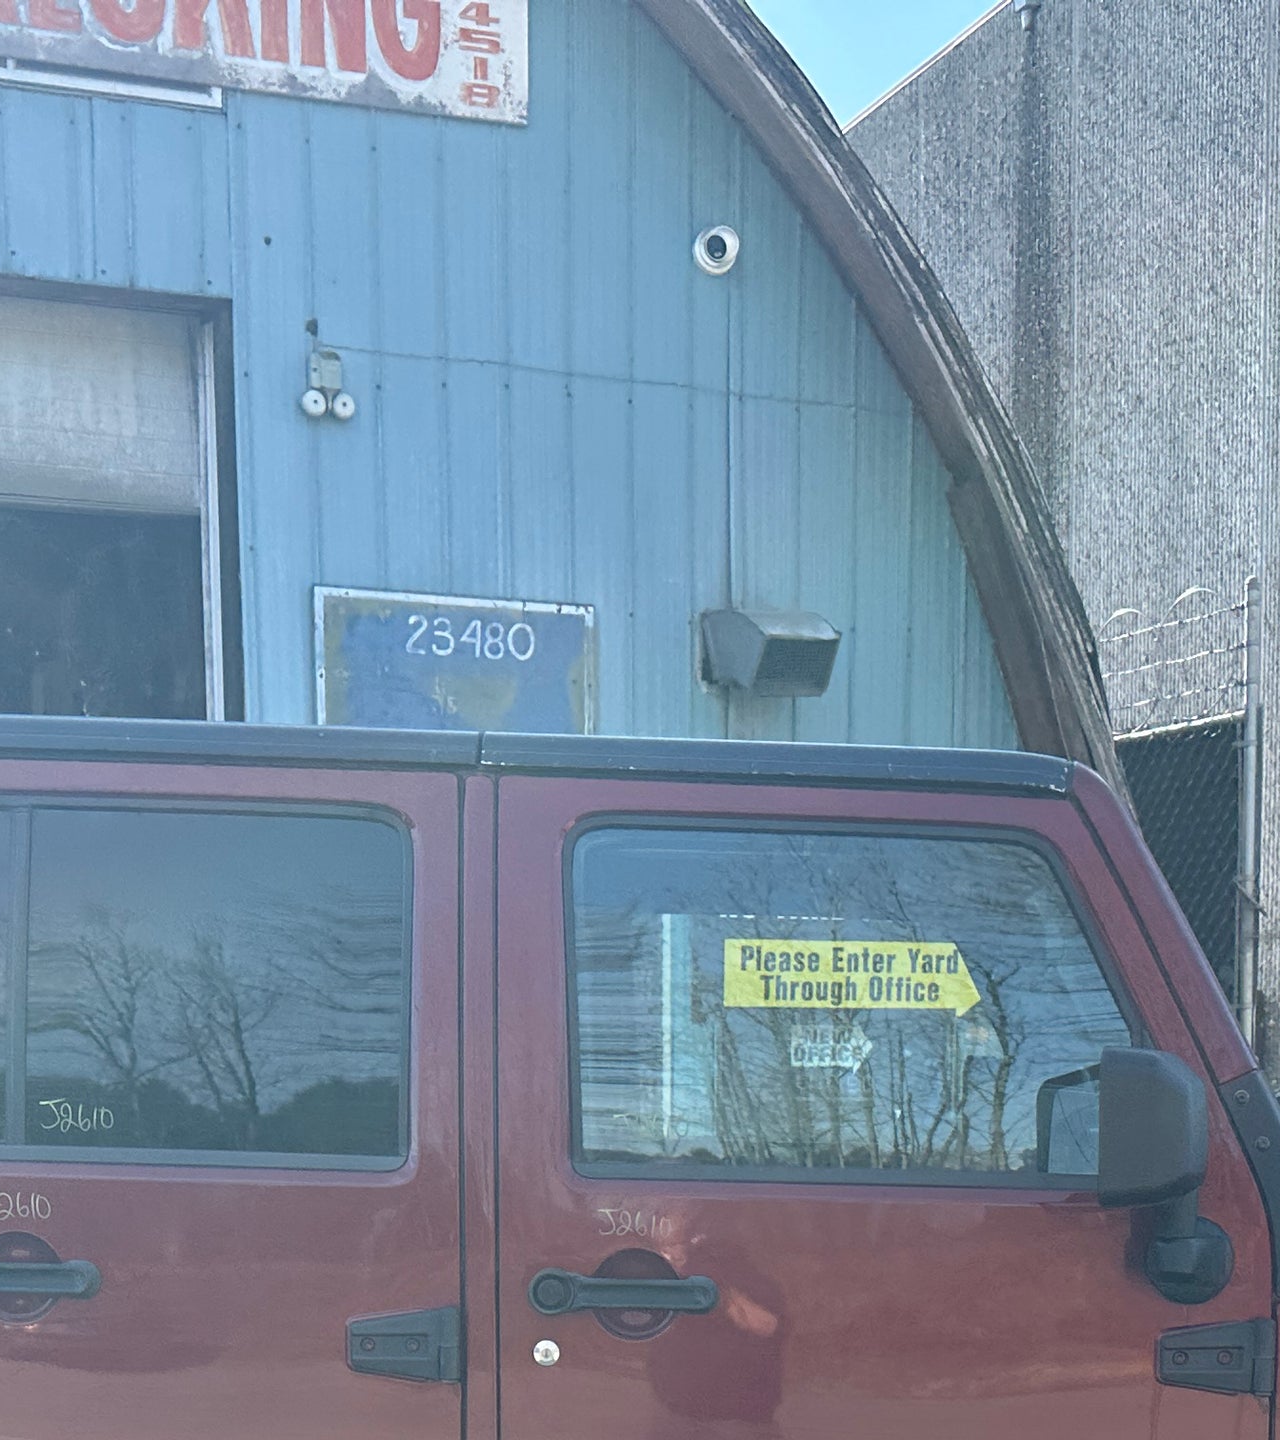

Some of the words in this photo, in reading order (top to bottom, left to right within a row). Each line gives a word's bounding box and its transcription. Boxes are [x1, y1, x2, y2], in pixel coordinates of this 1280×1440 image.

[405, 614, 535, 661] 23480
[740, 945, 820, 972] Please
[831, 947, 896, 973] Enter
[907, 948, 959, 974] Yard
[760, 975, 857, 1006] Through
[870, 976, 940, 1002] Office
[39, 1098, 114, 1132] J2610
